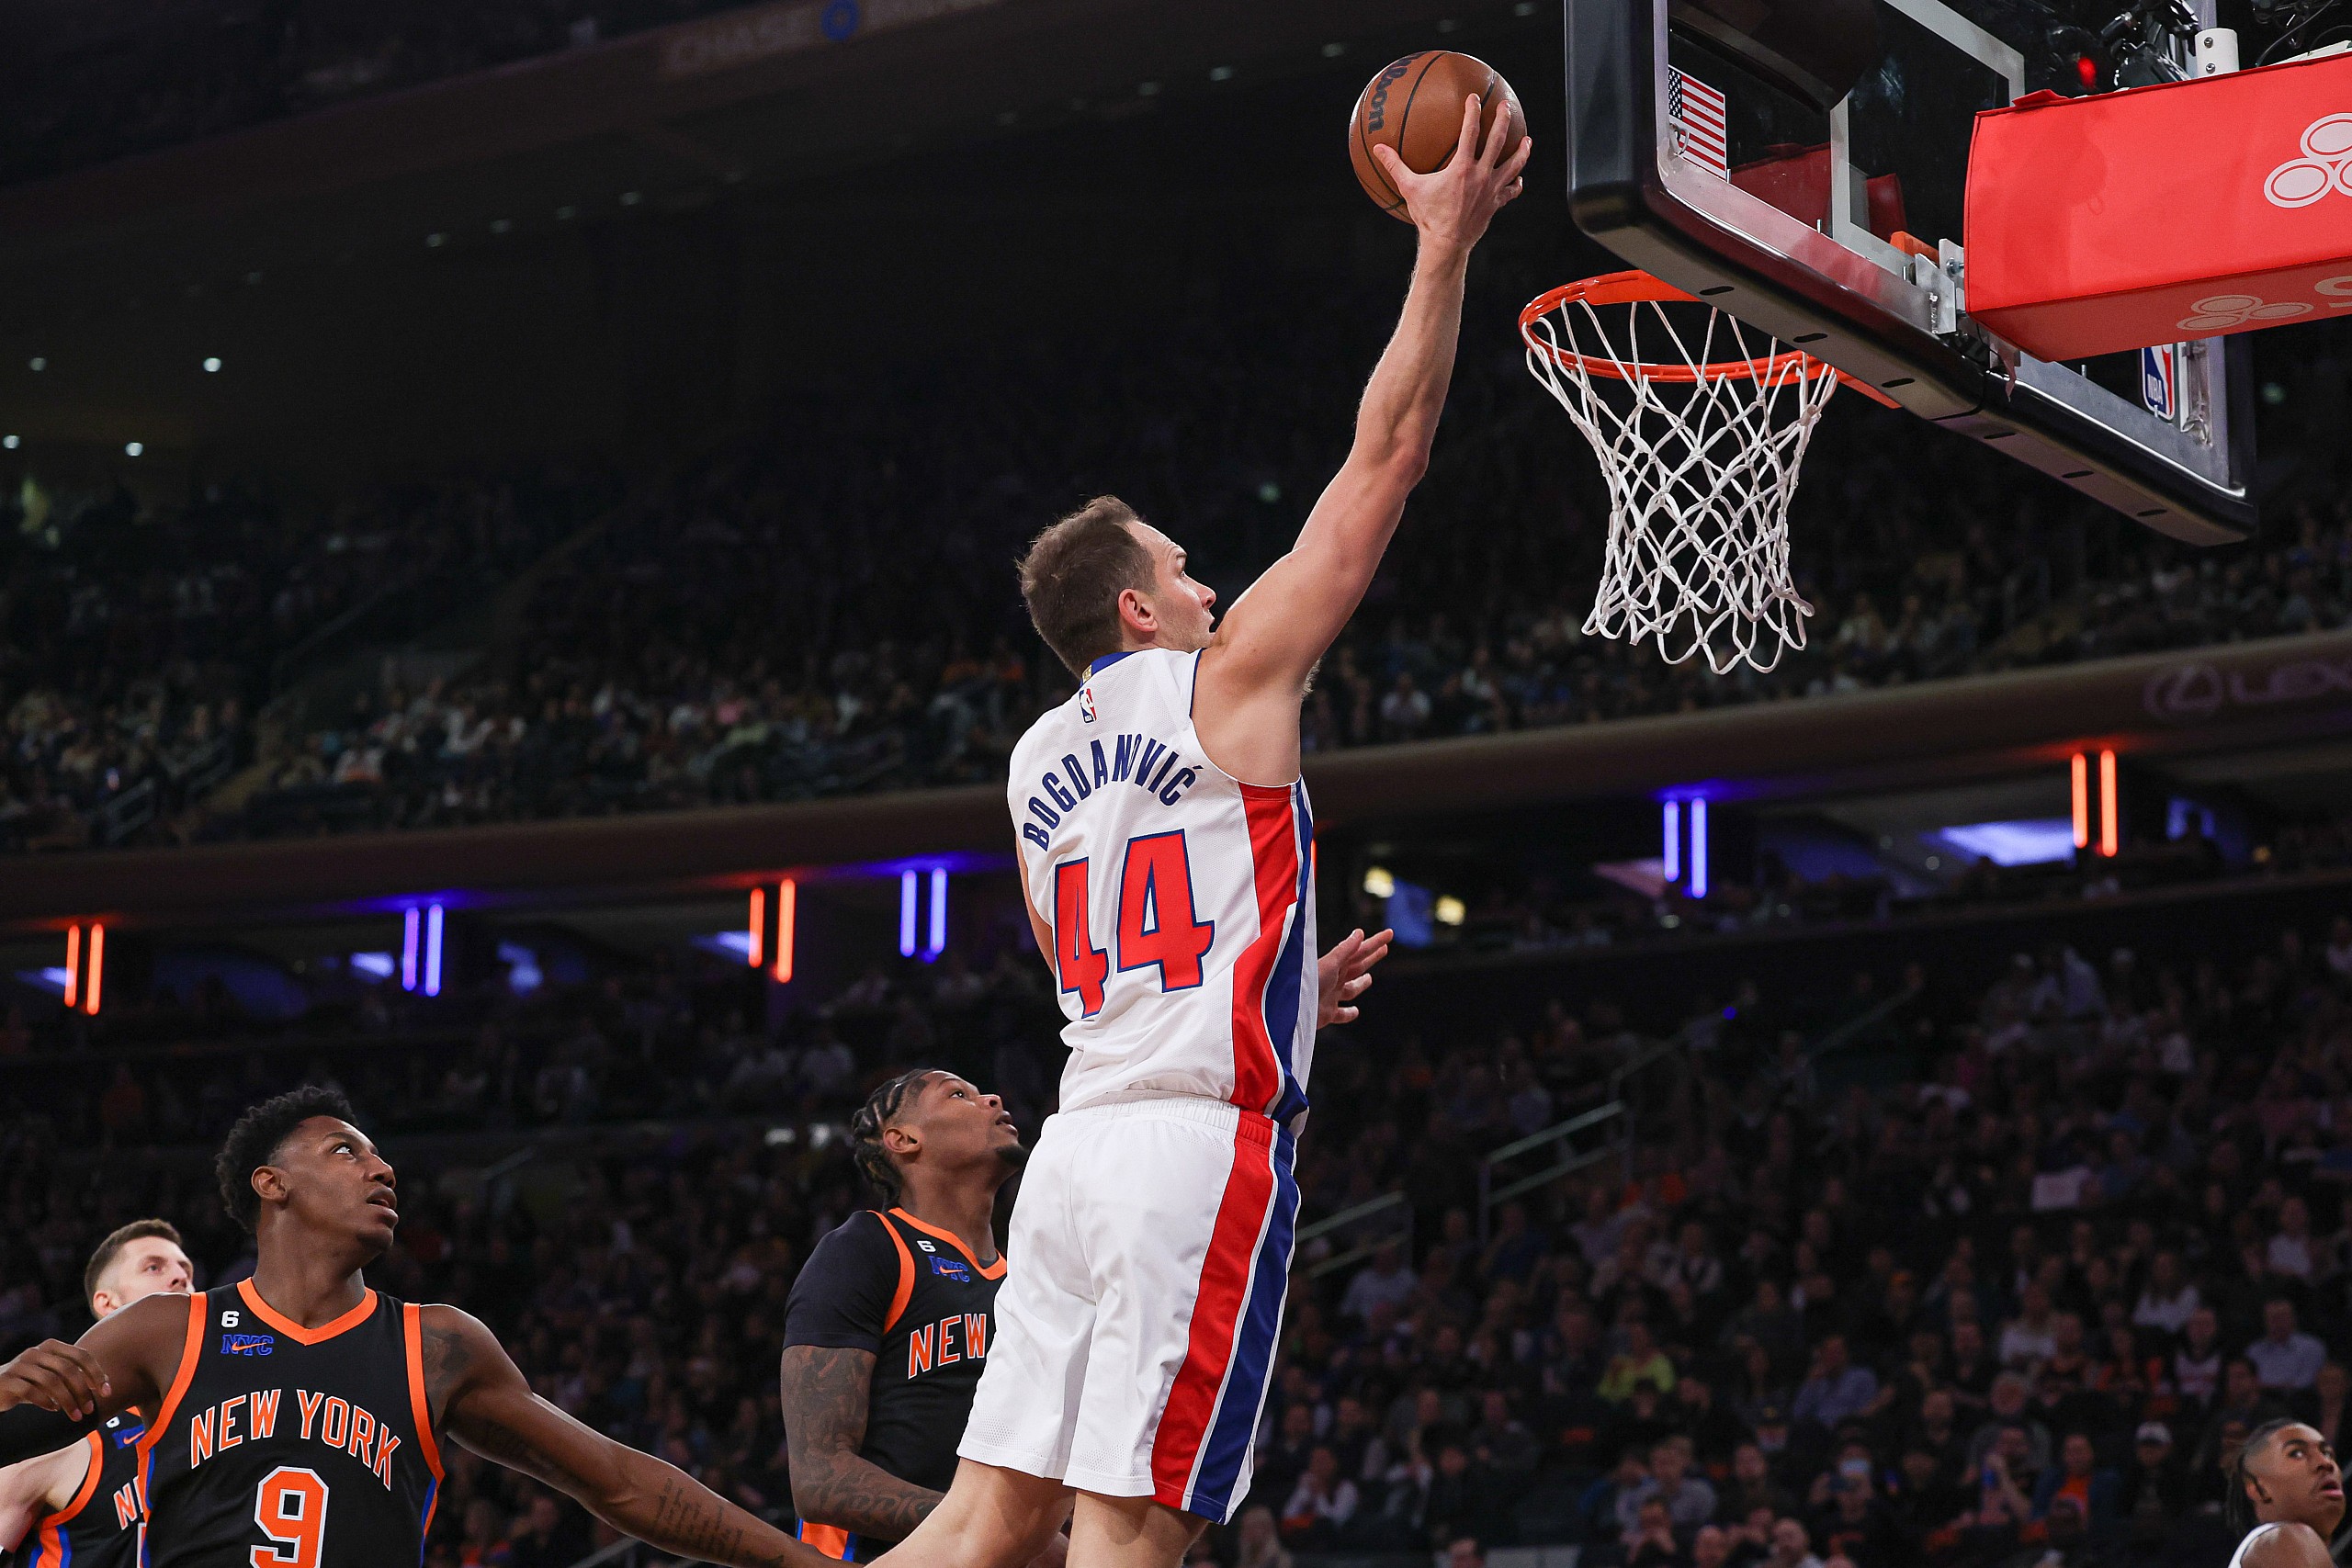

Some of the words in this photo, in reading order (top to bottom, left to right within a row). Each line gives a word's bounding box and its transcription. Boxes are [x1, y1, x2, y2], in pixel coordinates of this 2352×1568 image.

[2147, 373, 2164, 405] NBA
[1023, 733, 1203, 852] BOGDANOVIĆ
[1054, 829, 1215, 1019] 44
[916, 1240, 936, 1253] 6
[220, 1310, 240, 1328] 6
[220, 1334, 275, 1357] NYC
[908, 1313, 987, 1380] NEW
[190, 1389, 282, 1470] NEW
[296, 1389, 401, 1492] YORK
[250, 1465, 329, 1568] 9
